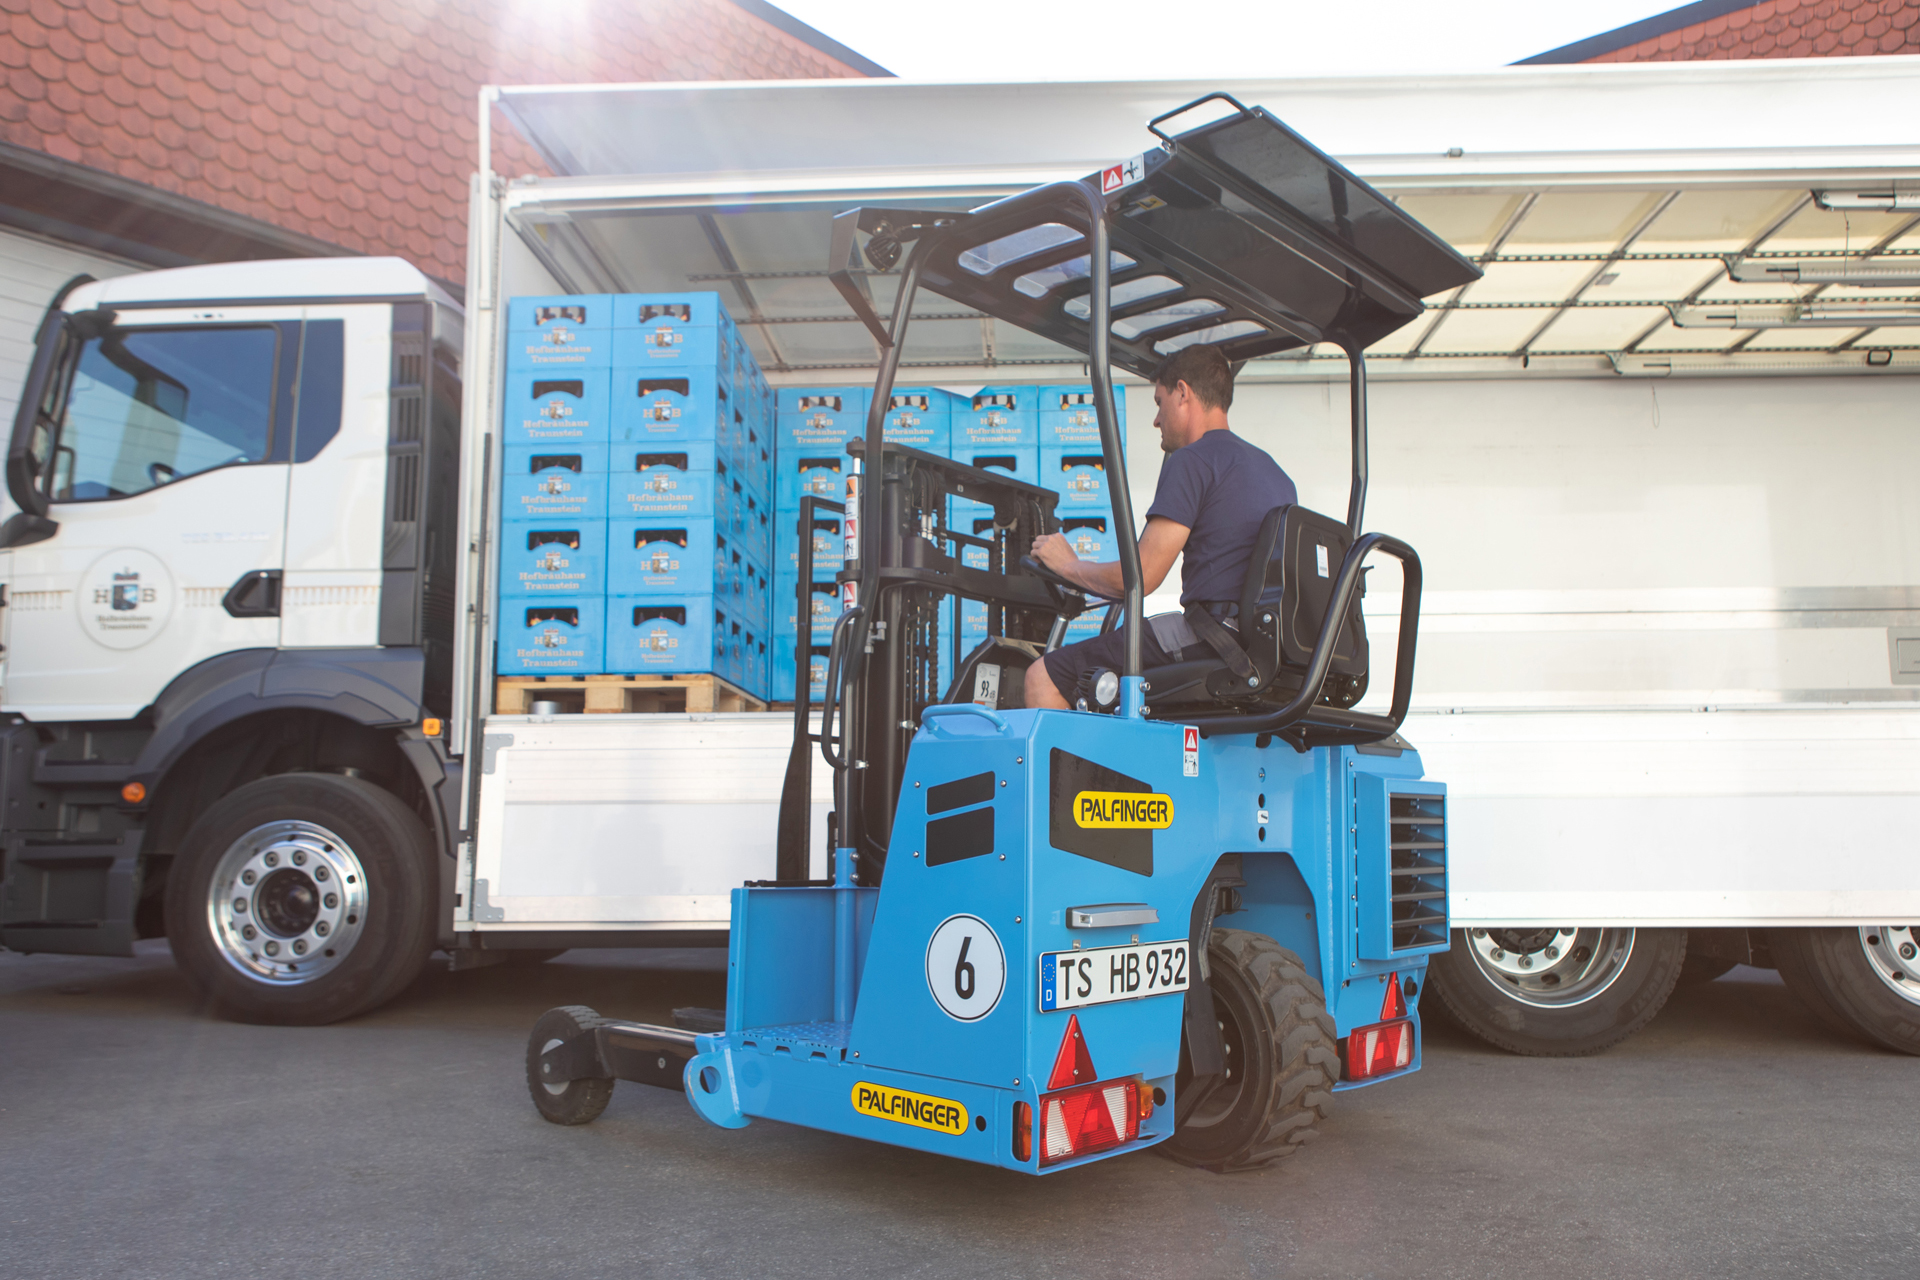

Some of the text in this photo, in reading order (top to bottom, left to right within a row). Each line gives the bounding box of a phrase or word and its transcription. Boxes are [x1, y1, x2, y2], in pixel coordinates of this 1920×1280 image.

[543, 332, 575, 342] H B
[645, 334, 683, 344] H B
[540, 407, 573, 416] H B
[643, 408, 681, 418] H B
[522, 420, 589, 428] Hofbräuhaus
[527, 429, 583, 438] Traunstein
[538, 483, 571, 492] H B
[644, 481, 677, 490] H B
[521, 496, 588, 504] Hofbräuhaus
[627, 494, 694, 502] Hofbräuhaus
[526, 505, 582, 513] Traunstein
[632, 503, 688, 511] Traunstein
[536, 558, 569, 568] H B
[640, 560, 680, 570] H B
[519, 571, 586, 580] Hofbräuhaus
[524, 581, 580, 590] Traunstein
[94, 588, 156, 603] H B
[534, 636, 567, 645] H B
[639, 638, 678, 648] H B
[516, 648, 584, 657] Hofbräuhaus
[522, 658, 578, 667] Traunstein
[980, 680, 990, 697] 93
[1081, 798, 1168, 822] PALFINGER
[955, 936, 975, 999] 6
[1046, 947, 1187, 1001] D TS HB 932
[859, 1087, 960, 1129] PALFINGER
